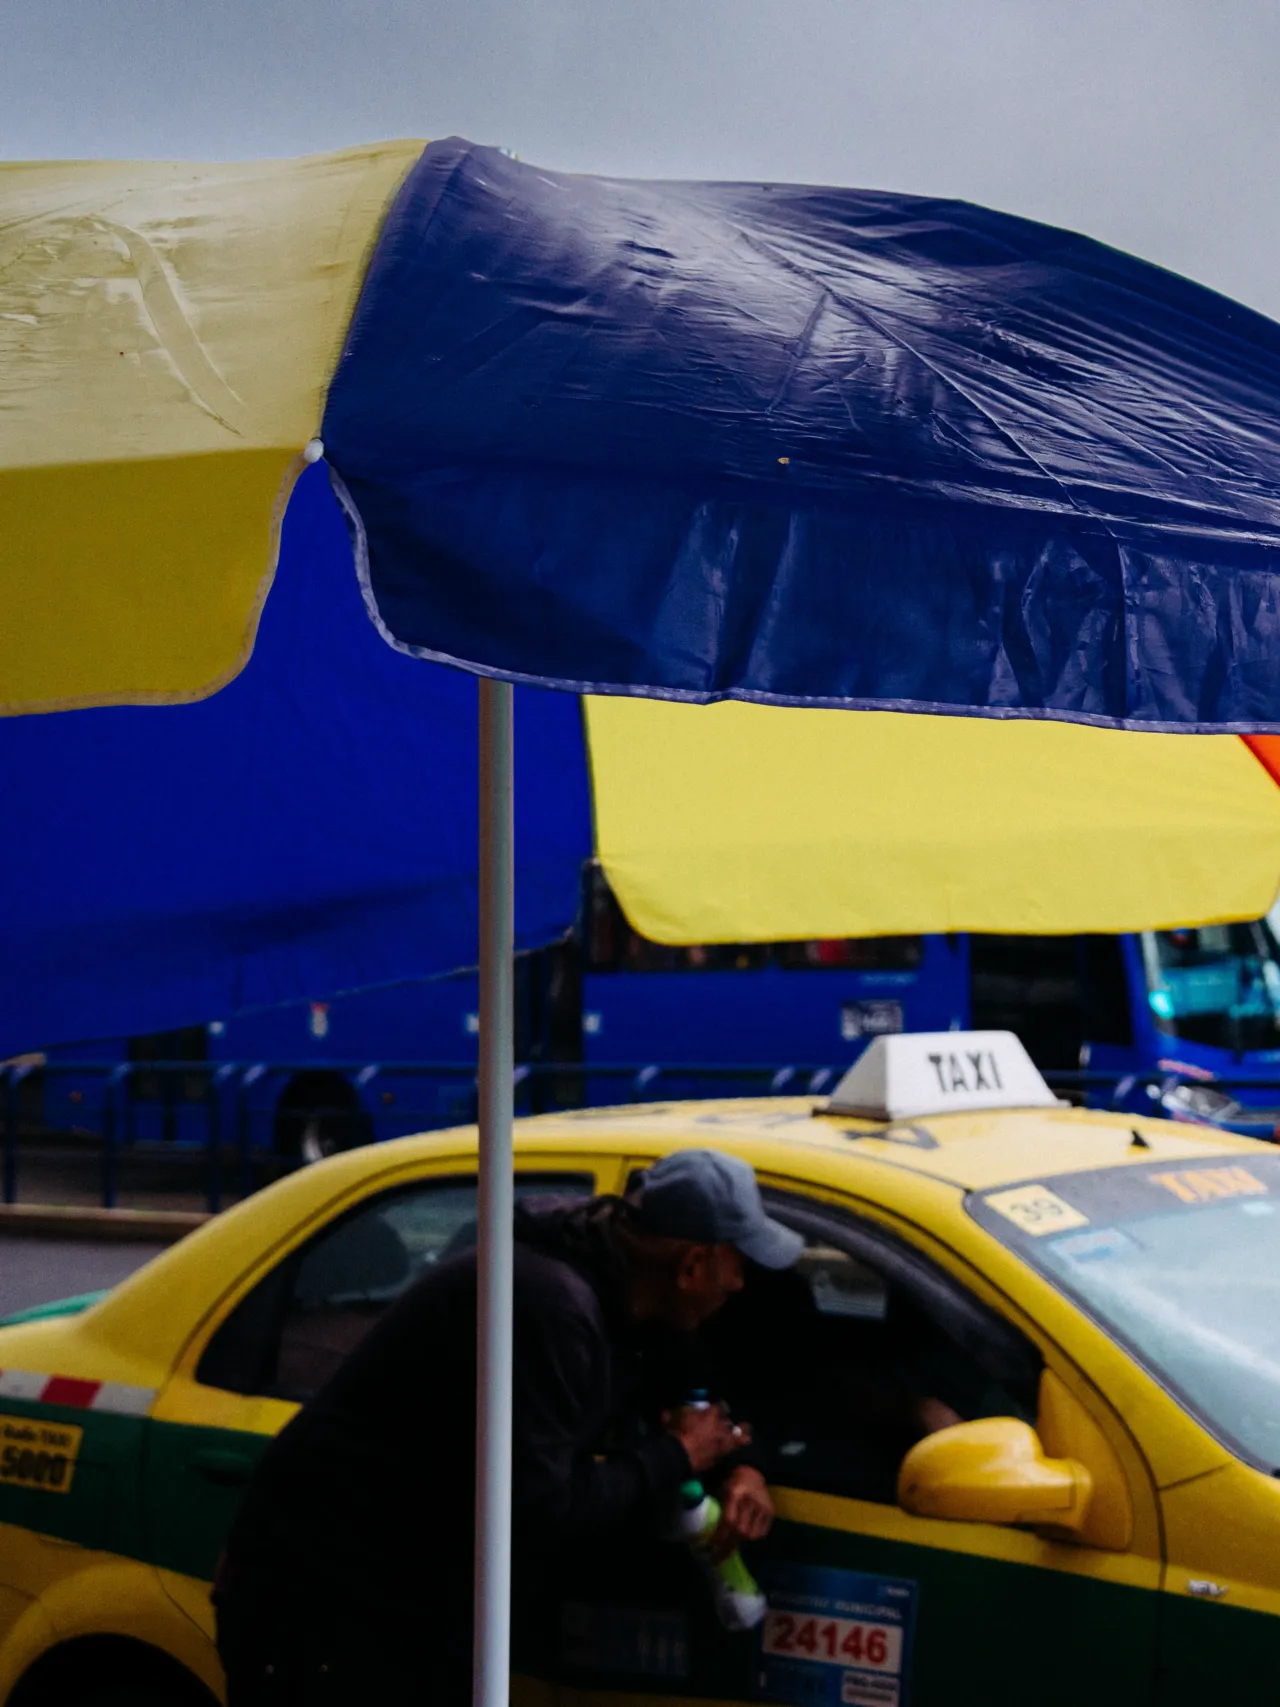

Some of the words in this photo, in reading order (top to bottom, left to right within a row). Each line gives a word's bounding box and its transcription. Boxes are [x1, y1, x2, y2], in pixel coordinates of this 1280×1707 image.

[927, 1051, 1003, 1092] TAXI
[1148, 1166, 1268, 1204] TAXI
[1009, 1197, 1064, 1222] 39
[772, 1614, 888, 1665] 24146
